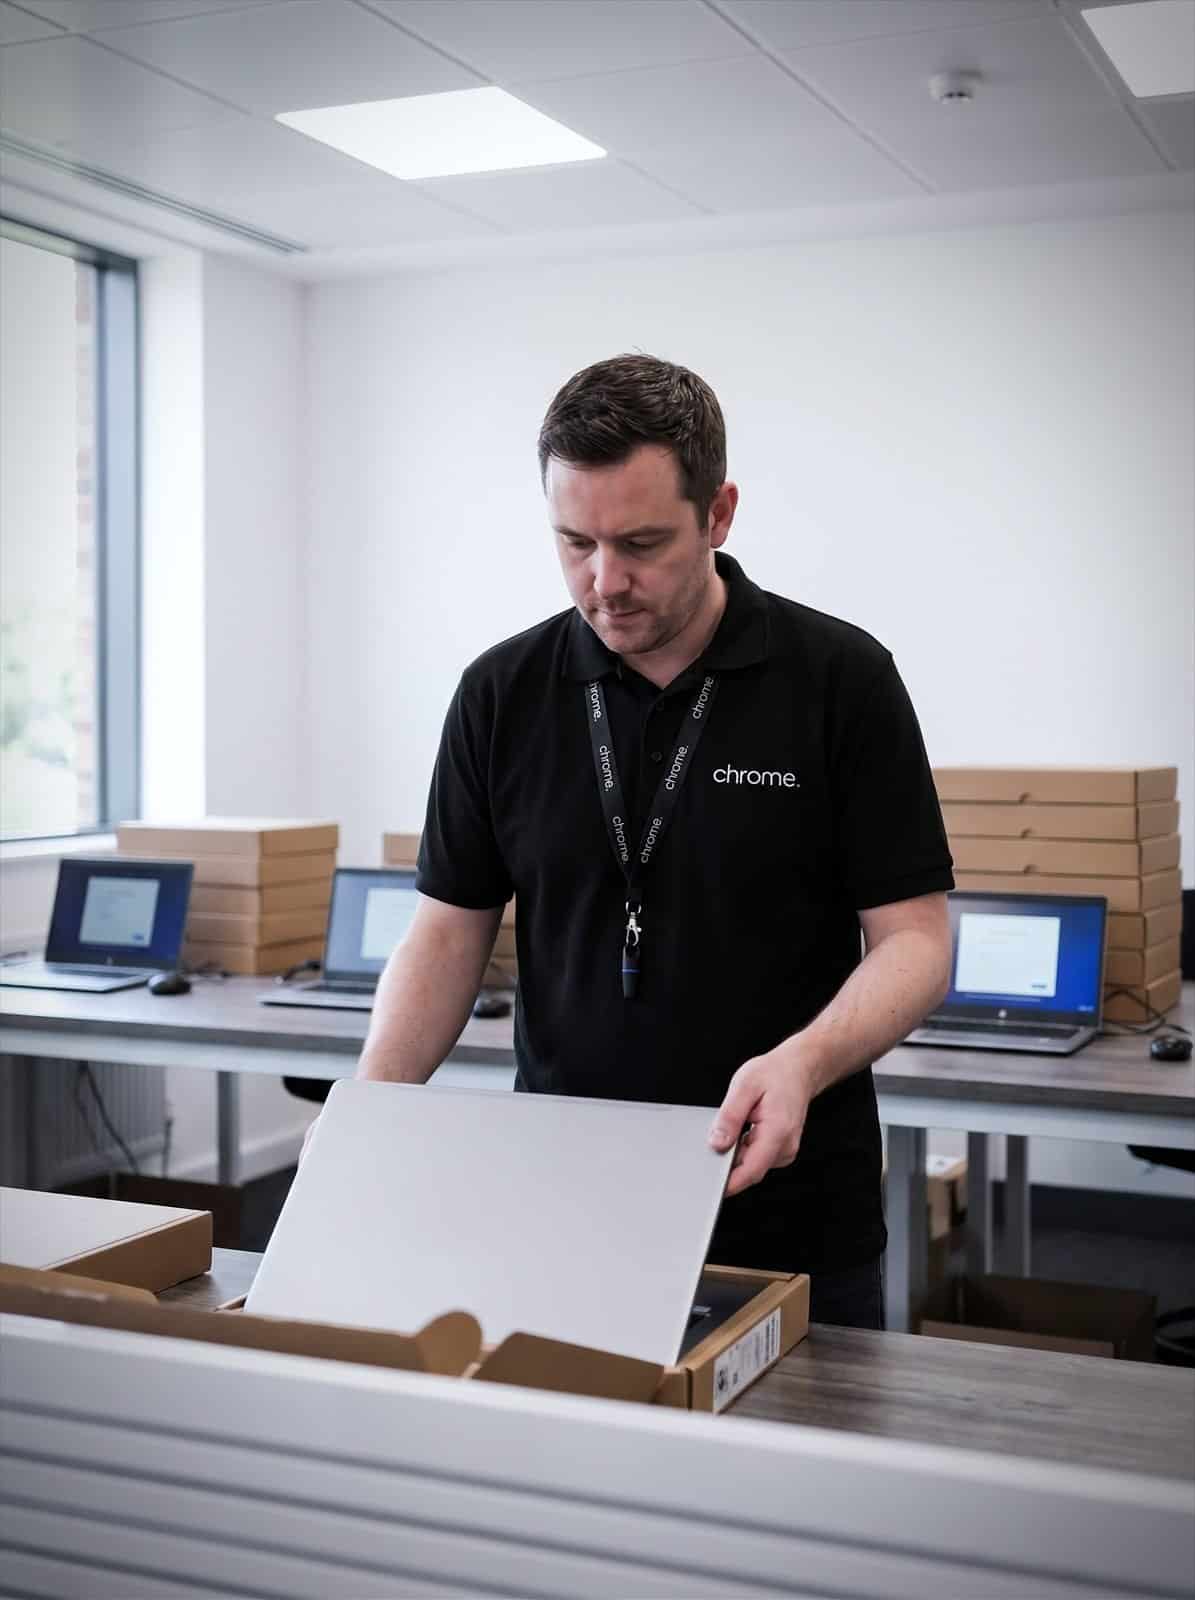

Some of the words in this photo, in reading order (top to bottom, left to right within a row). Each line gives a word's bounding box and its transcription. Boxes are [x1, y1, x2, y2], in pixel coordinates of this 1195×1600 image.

[589, 681, 601, 722] hrome.
[599, 745, 613, 792] chrome.
[665, 745, 689, 790] chrome.
[711, 763, 801, 788] chrome.
